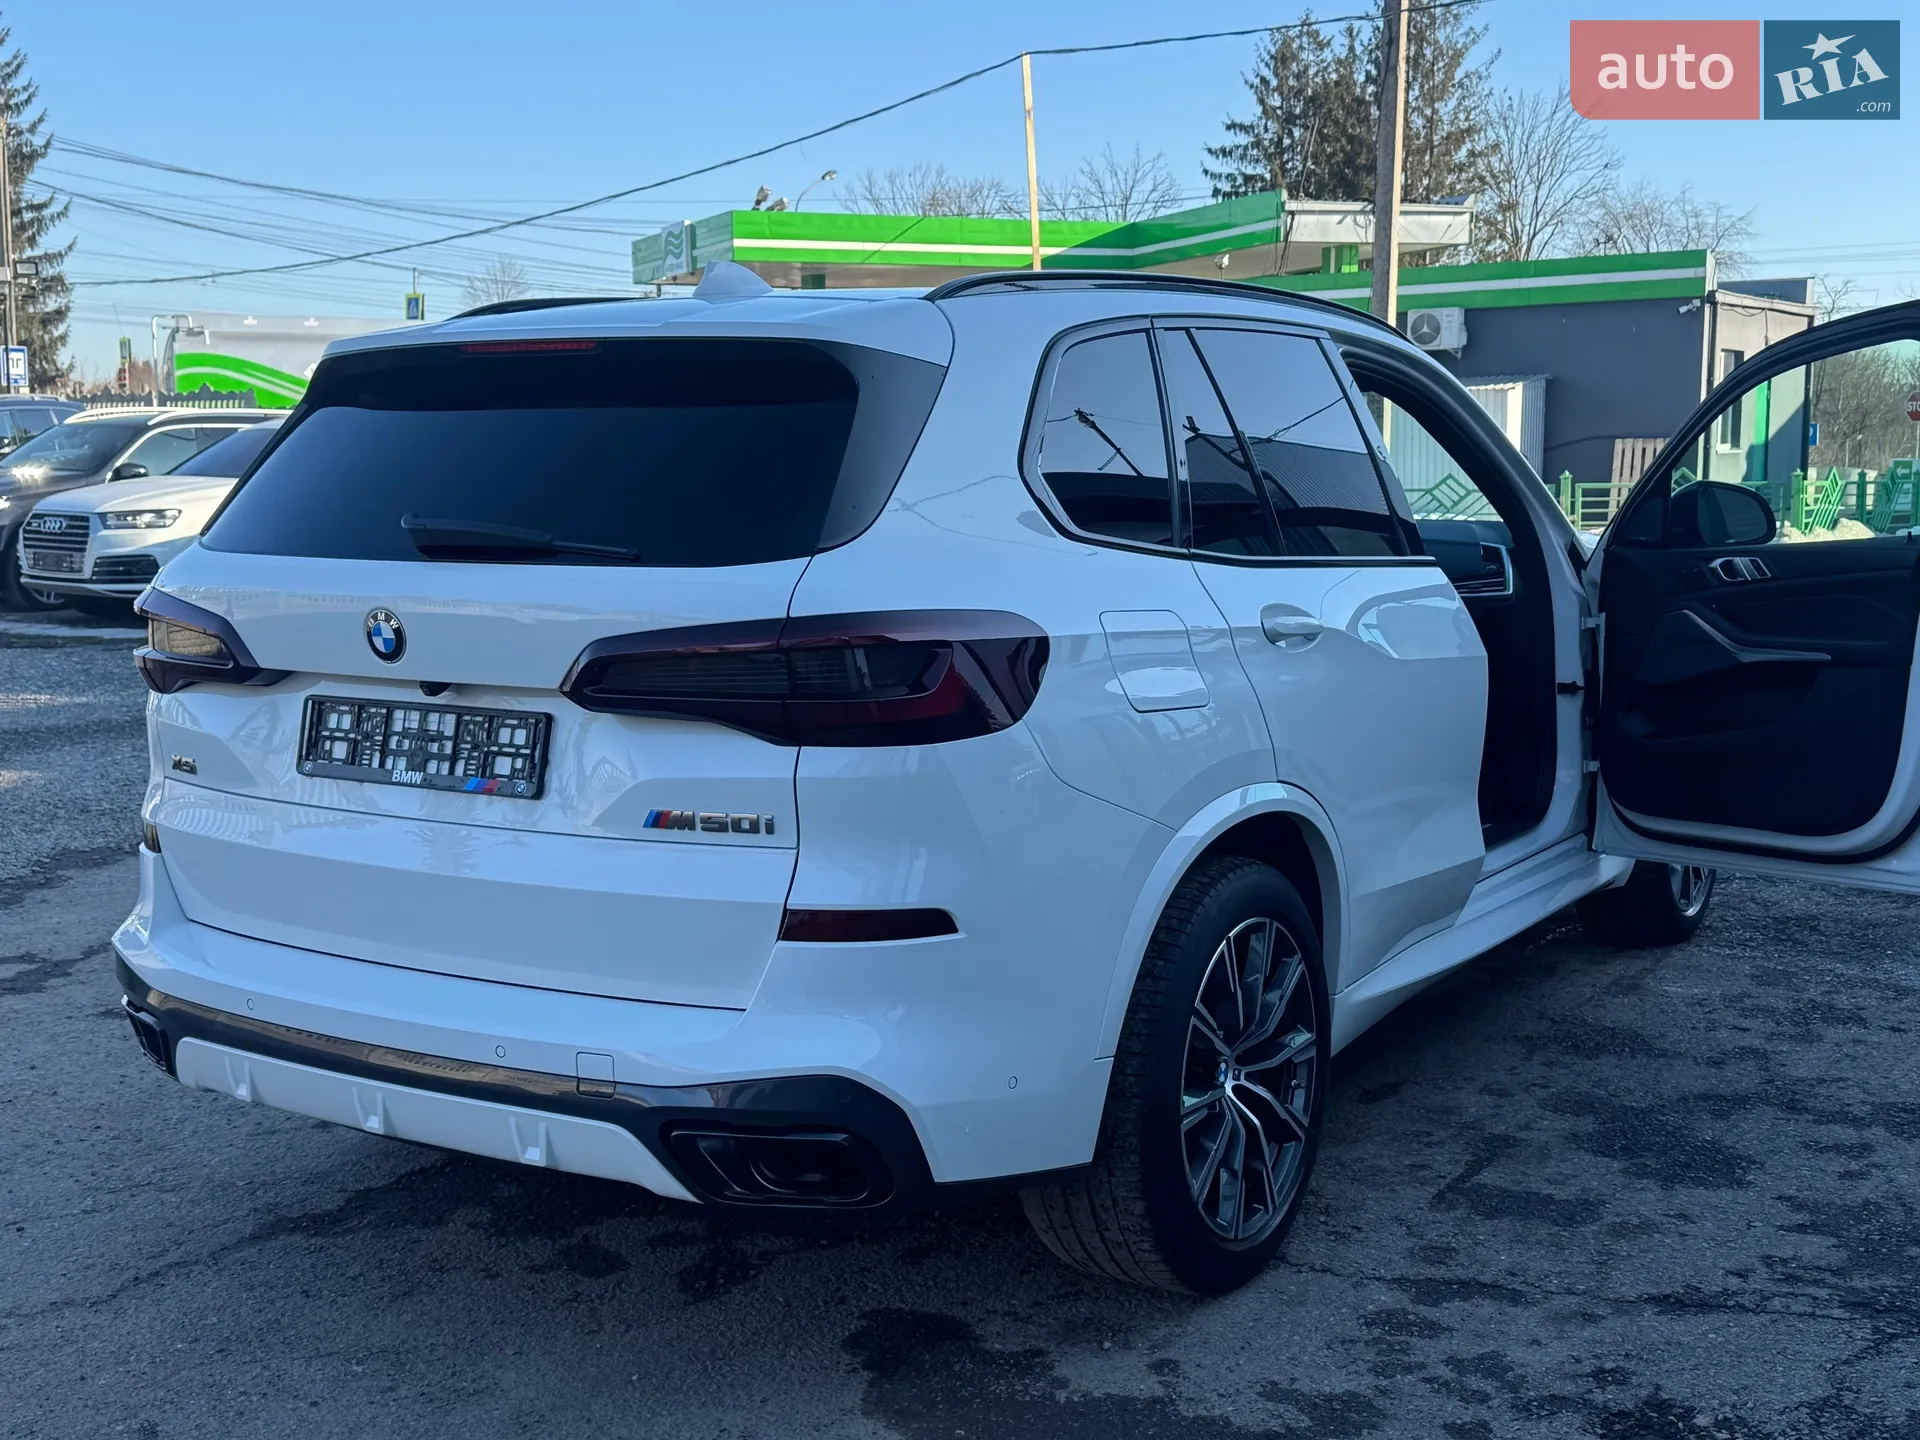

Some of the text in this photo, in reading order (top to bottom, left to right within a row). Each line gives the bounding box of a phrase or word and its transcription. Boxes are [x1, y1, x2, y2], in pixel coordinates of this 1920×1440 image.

[367, 611, 399, 629] BMW
[391, 769, 424, 785] BMW
[666, 809, 775, 835] M50i
